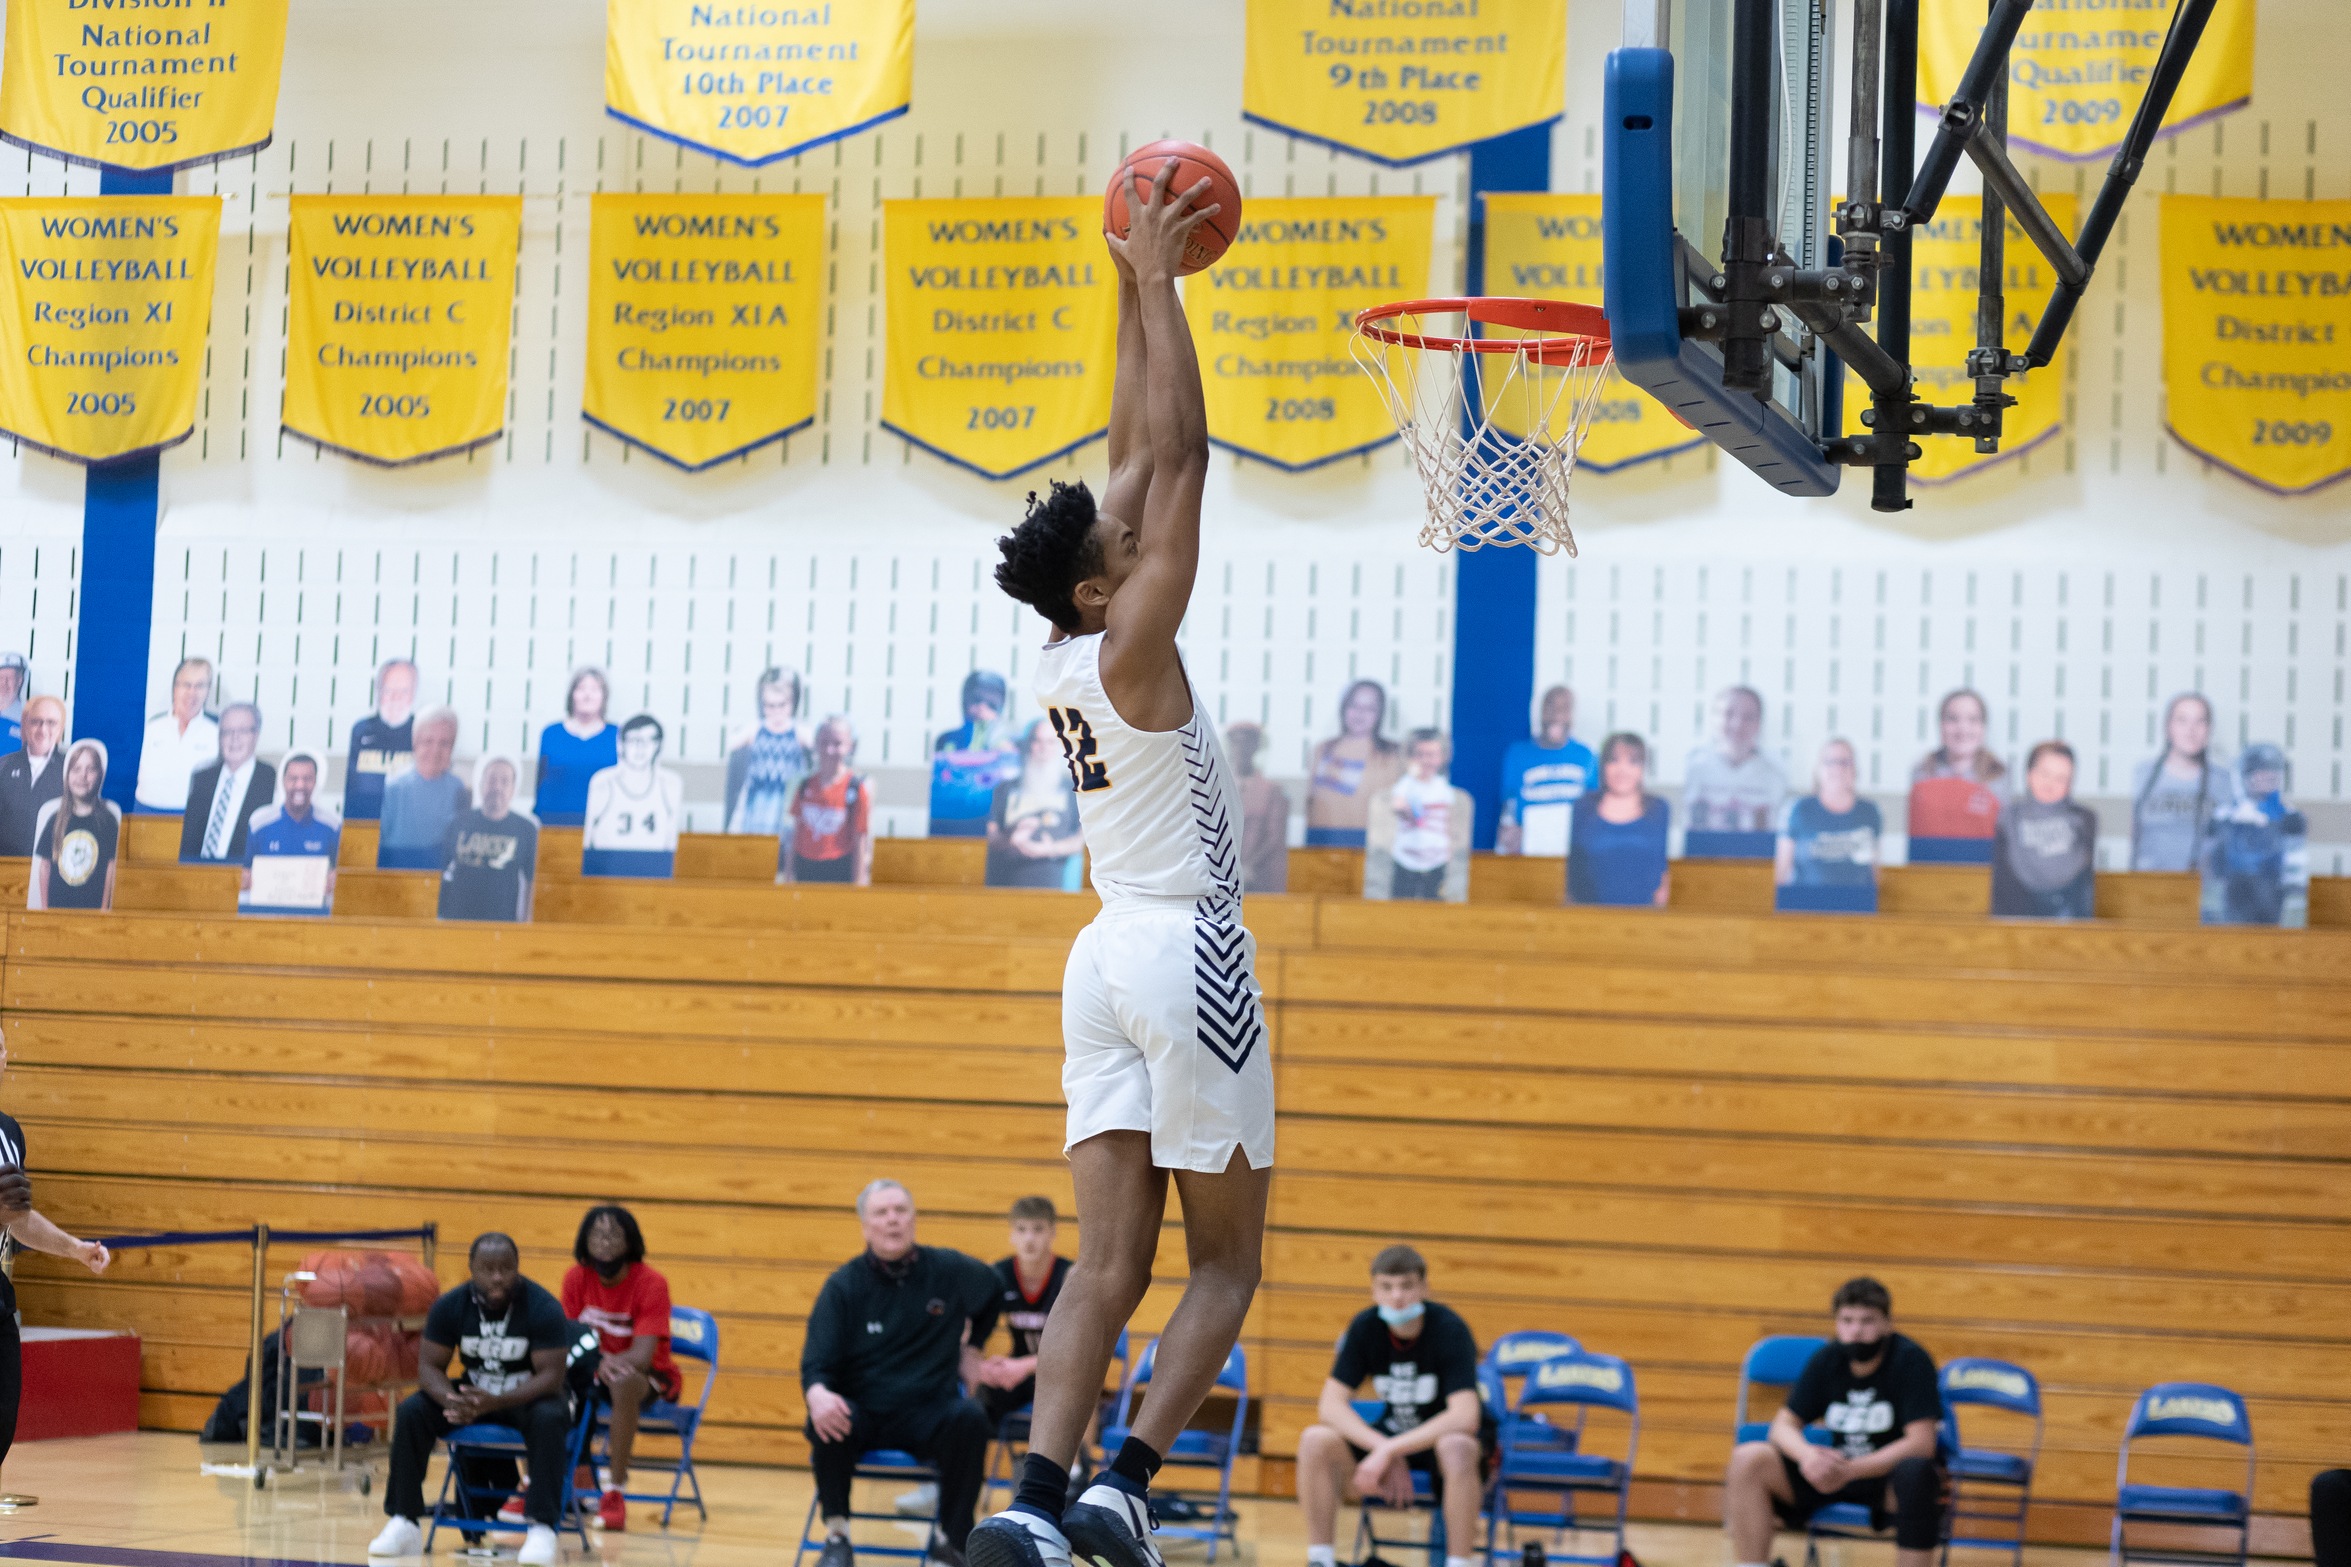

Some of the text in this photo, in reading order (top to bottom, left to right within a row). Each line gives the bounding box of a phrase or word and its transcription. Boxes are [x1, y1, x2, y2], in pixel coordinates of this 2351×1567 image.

[690, 3, 831, 27] National
[1329, 0, 1478, 18] National
[82, 22, 211, 46] National
[1302, 30, 1508, 55] Tournament
[1978, 27, 2165, 50] urname
[660, 37, 859, 61] Tournament
[54, 52, 238, 76] Tournament
[1329, 63, 1481, 90] 9th Place
[684, 72, 833, 96] 10th Place
[81, 86, 203, 114] Qualifier
[2042, 98, 2122, 125] 2009
[718, 104, 790, 129] 2007
[1364, 100, 1439, 126] 2008
[106, 120, 178, 144] 2005
[41, 215, 180, 239] WOMEN'S
[333, 213, 475, 238] WOMEN'S
[633, 213, 780, 239] WOMEN'S
[928, 216, 1079, 244] WOMEN'S
[20, 258, 195, 281] VOLLEYBALL
[312, 256, 493, 281] VOLLEYBALL
[612, 258, 797, 283] VOLLEYBALL
[909, 263, 1099, 290] VOLLEYBALL
[1208, 264, 1404, 292] VOLLEYBALL
[34, 301, 173, 330] Region XI
[334, 300, 465, 324] District C
[614, 302, 715, 333] Region
[933, 305, 1073, 333] District C
[1212, 310, 1317, 341] Region
[2216, 315, 2335, 345] District
[28, 344, 179, 374] Champions
[318, 343, 478, 374] Champions
[617, 346, 781, 378] Champions
[917, 355, 1085, 386] Champions
[66, 392, 136, 416] 2005
[359, 393, 431, 418] 2005
[663, 397, 732, 422] 2007
[1265, 397, 1337, 422] 2008
[966, 406, 1037, 431] 2007
[2253, 418, 2333, 447] 2009
[1048, 705, 1112, 793] 12
[617, 811, 656, 834] 34
